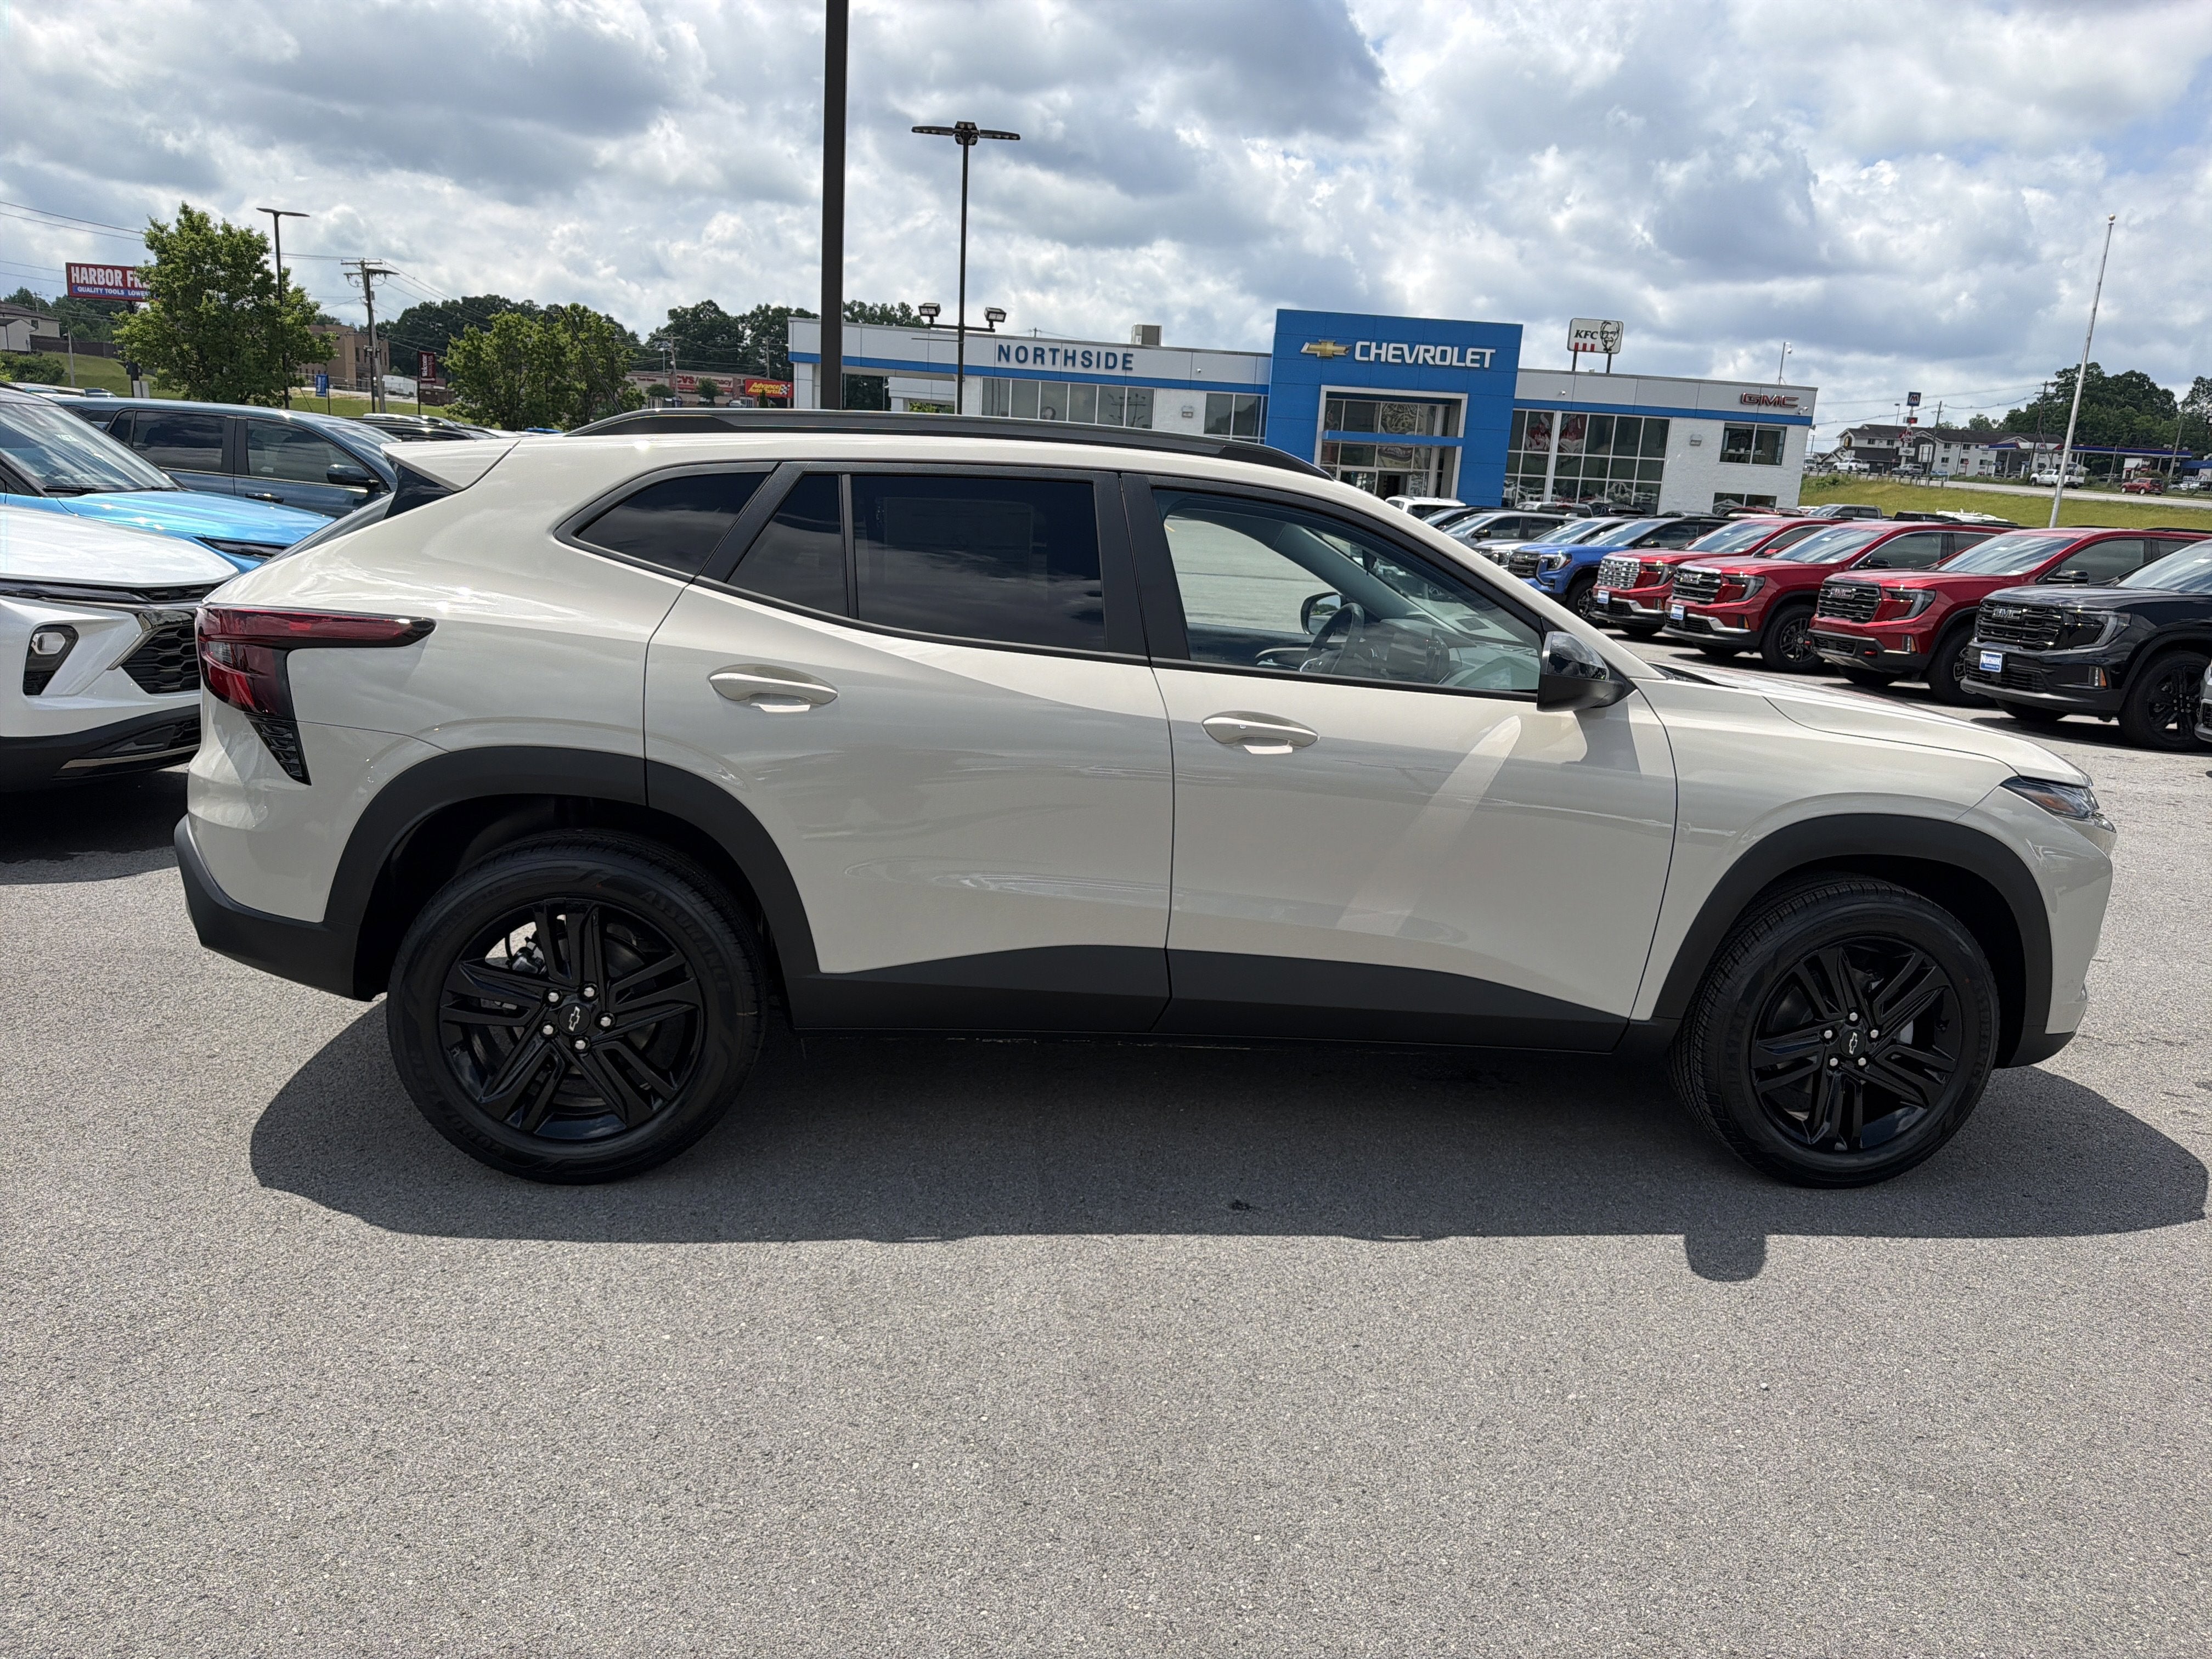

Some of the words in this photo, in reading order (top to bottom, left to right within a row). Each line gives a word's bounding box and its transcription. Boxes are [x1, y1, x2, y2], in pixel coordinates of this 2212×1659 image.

[71, 266, 123, 287] HARBOR
[77, 286, 103, 294] QUALITY
[1573, 329, 1599, 340] KFC
[997, 344, 1134, 371] NORTHSIDE
[1355, 341, 1496, 368] CHEVROLET
[1740, 392, 1799, 408] GMC
[1992, 607, 2022, 620] GMC
